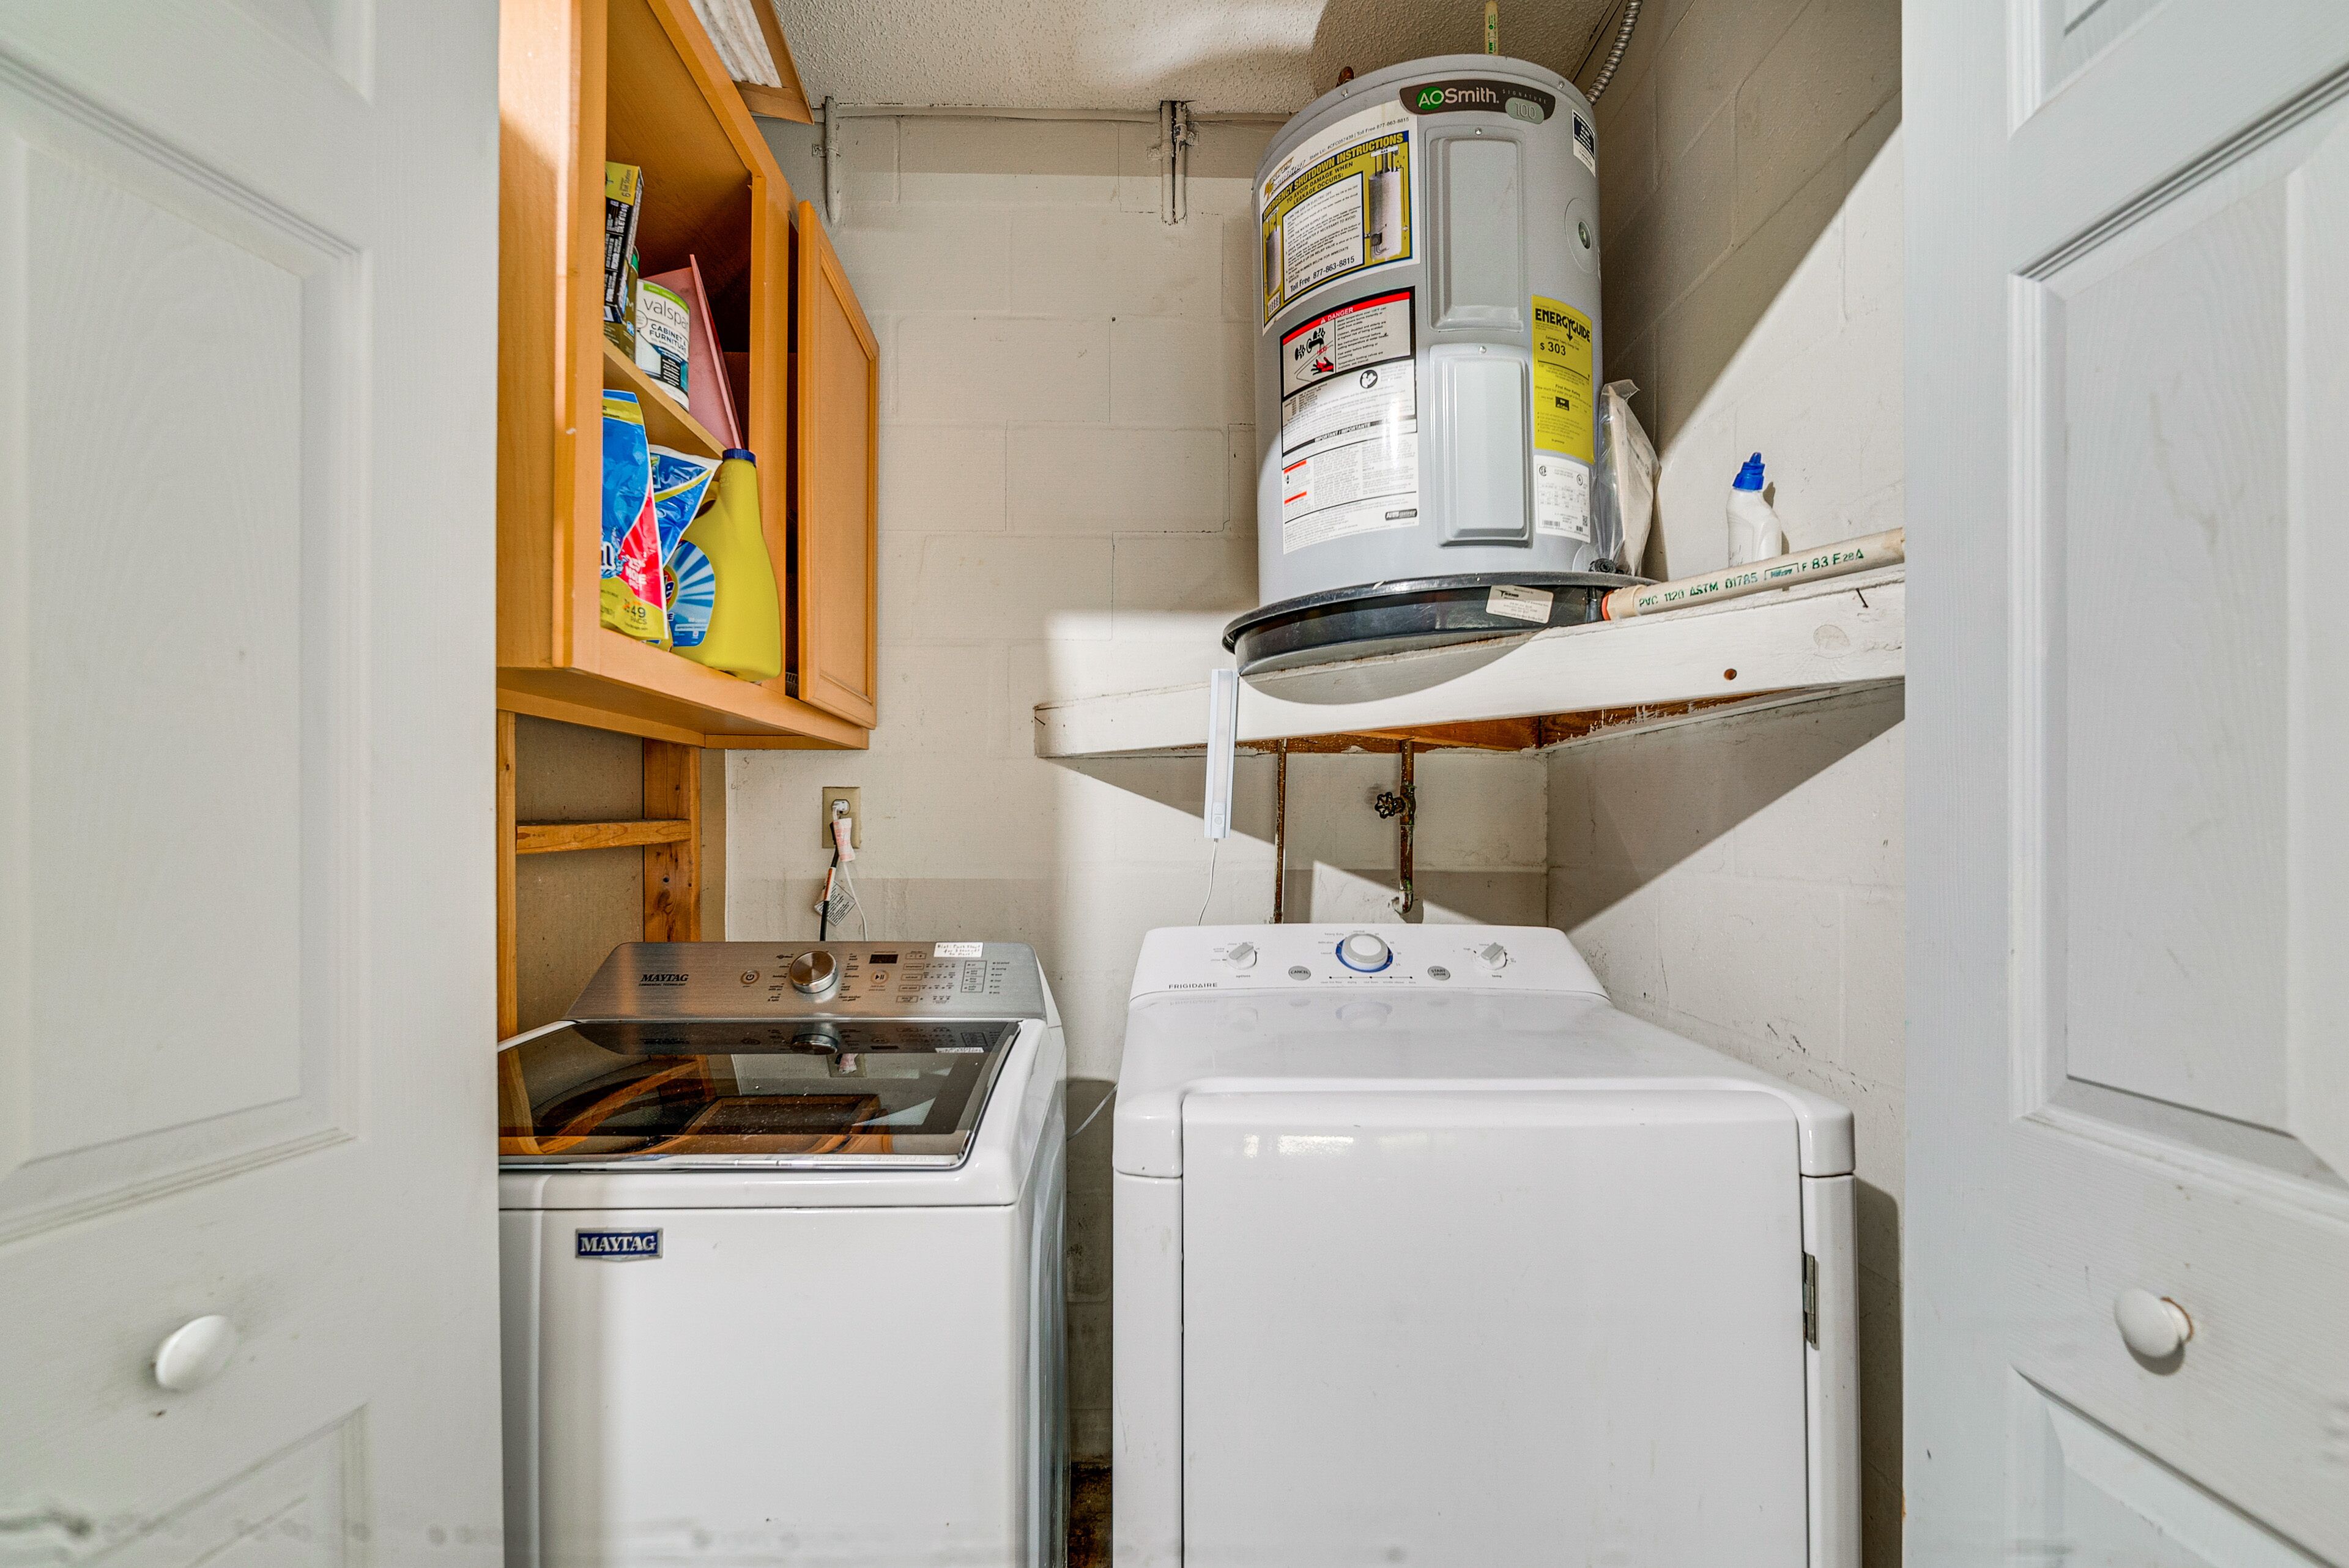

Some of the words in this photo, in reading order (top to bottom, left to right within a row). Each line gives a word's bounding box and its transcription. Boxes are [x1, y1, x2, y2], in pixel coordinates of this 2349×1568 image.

[1502, 89, 1547, 105] SIGNATURE
[1515, 102, 1536, 119] 100
[1263, 184, 1294, 219] EMERGENCY
[1294, 157, 1335, 189] SHUTDOWN
[1337, 132, 1404, 165] INSTRUCTIONS
[1294, 185, 1308, 198] AVOID
[1310, 171, 1334, 188] DAMAGE
[1335, 162, 1353, 173] WHEN
[1293, 187, 1316, 204] LEAKAGE
[1290, 282, 1299, 292] Toll
[1299, 276, 1310, 287] Free
[1313, 256, 1355, 278] 877-863-8815
[644, 299, 688, 330] valspa
[1327, 307, 1354, 321] DANGER
[651, 323, 683, 342] CABINET
[1548, 341, 1565, 356] 303
[1639, 595, 1658, 607] PVC
[1690, 581, 1718, 596] ASTM
[581, 1235, 656, 1252] MAYTAG
